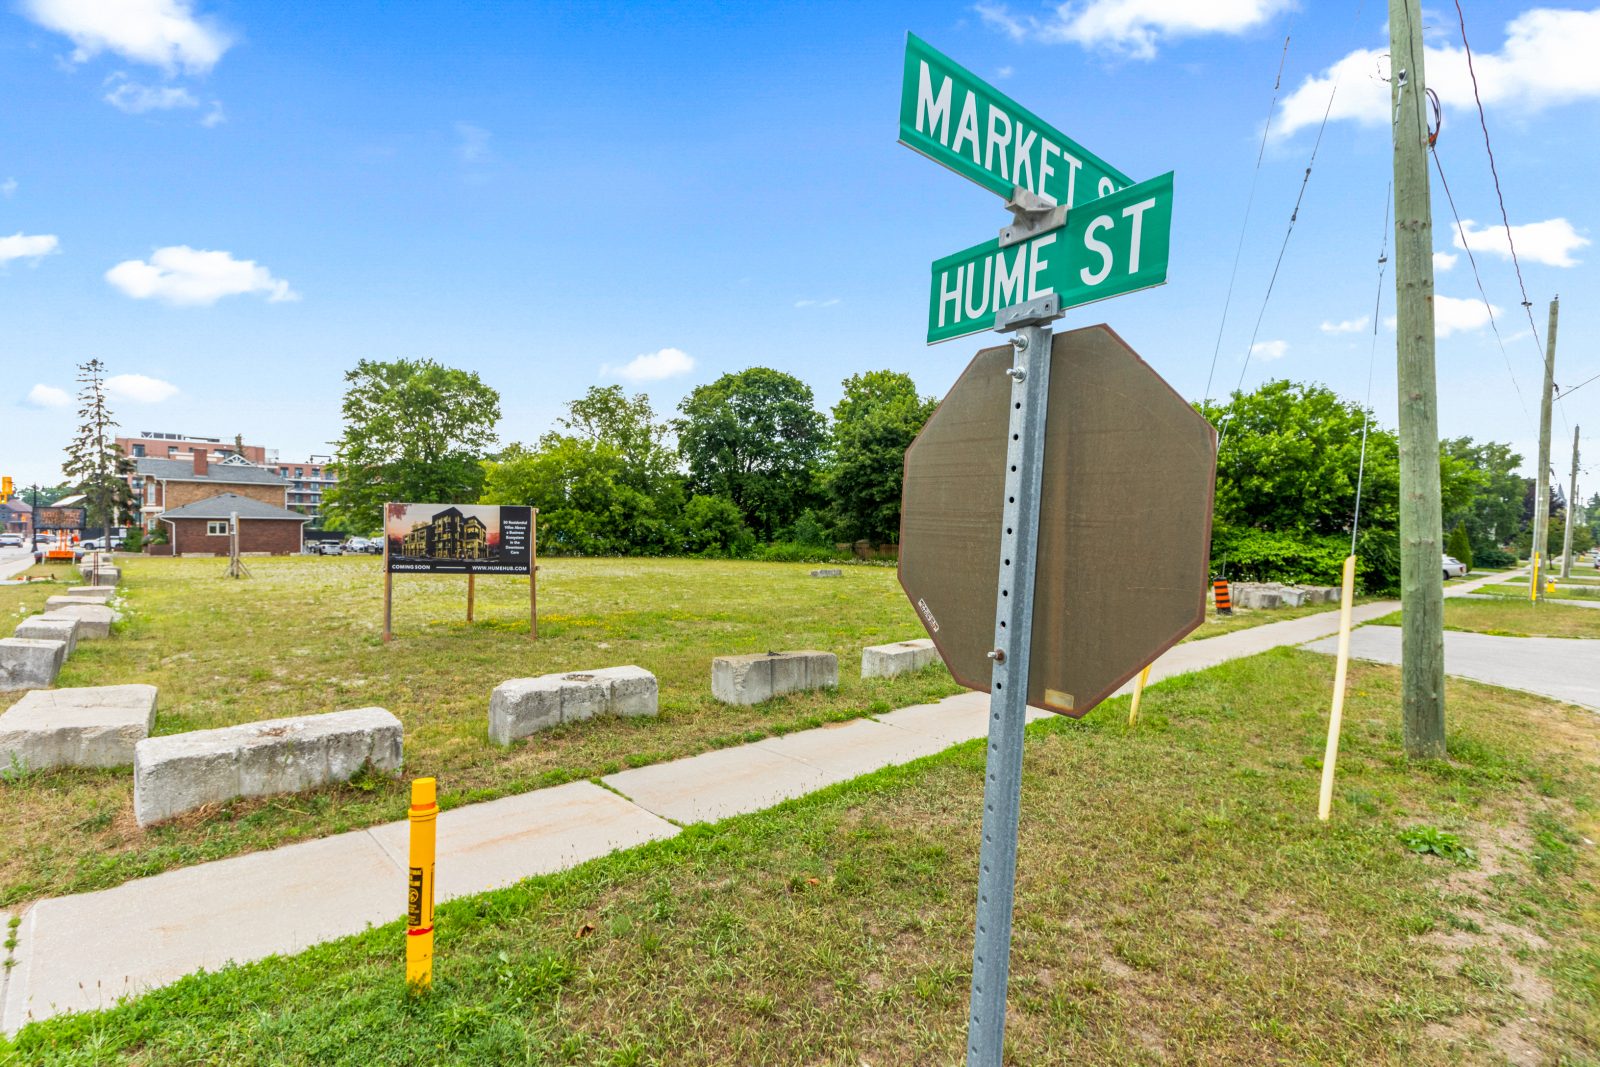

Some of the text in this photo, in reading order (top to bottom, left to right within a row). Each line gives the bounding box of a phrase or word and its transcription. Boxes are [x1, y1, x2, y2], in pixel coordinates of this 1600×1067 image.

[915, 59, 1083, 208] MARKET
[937, 197, 1156, 328] HUME ST
